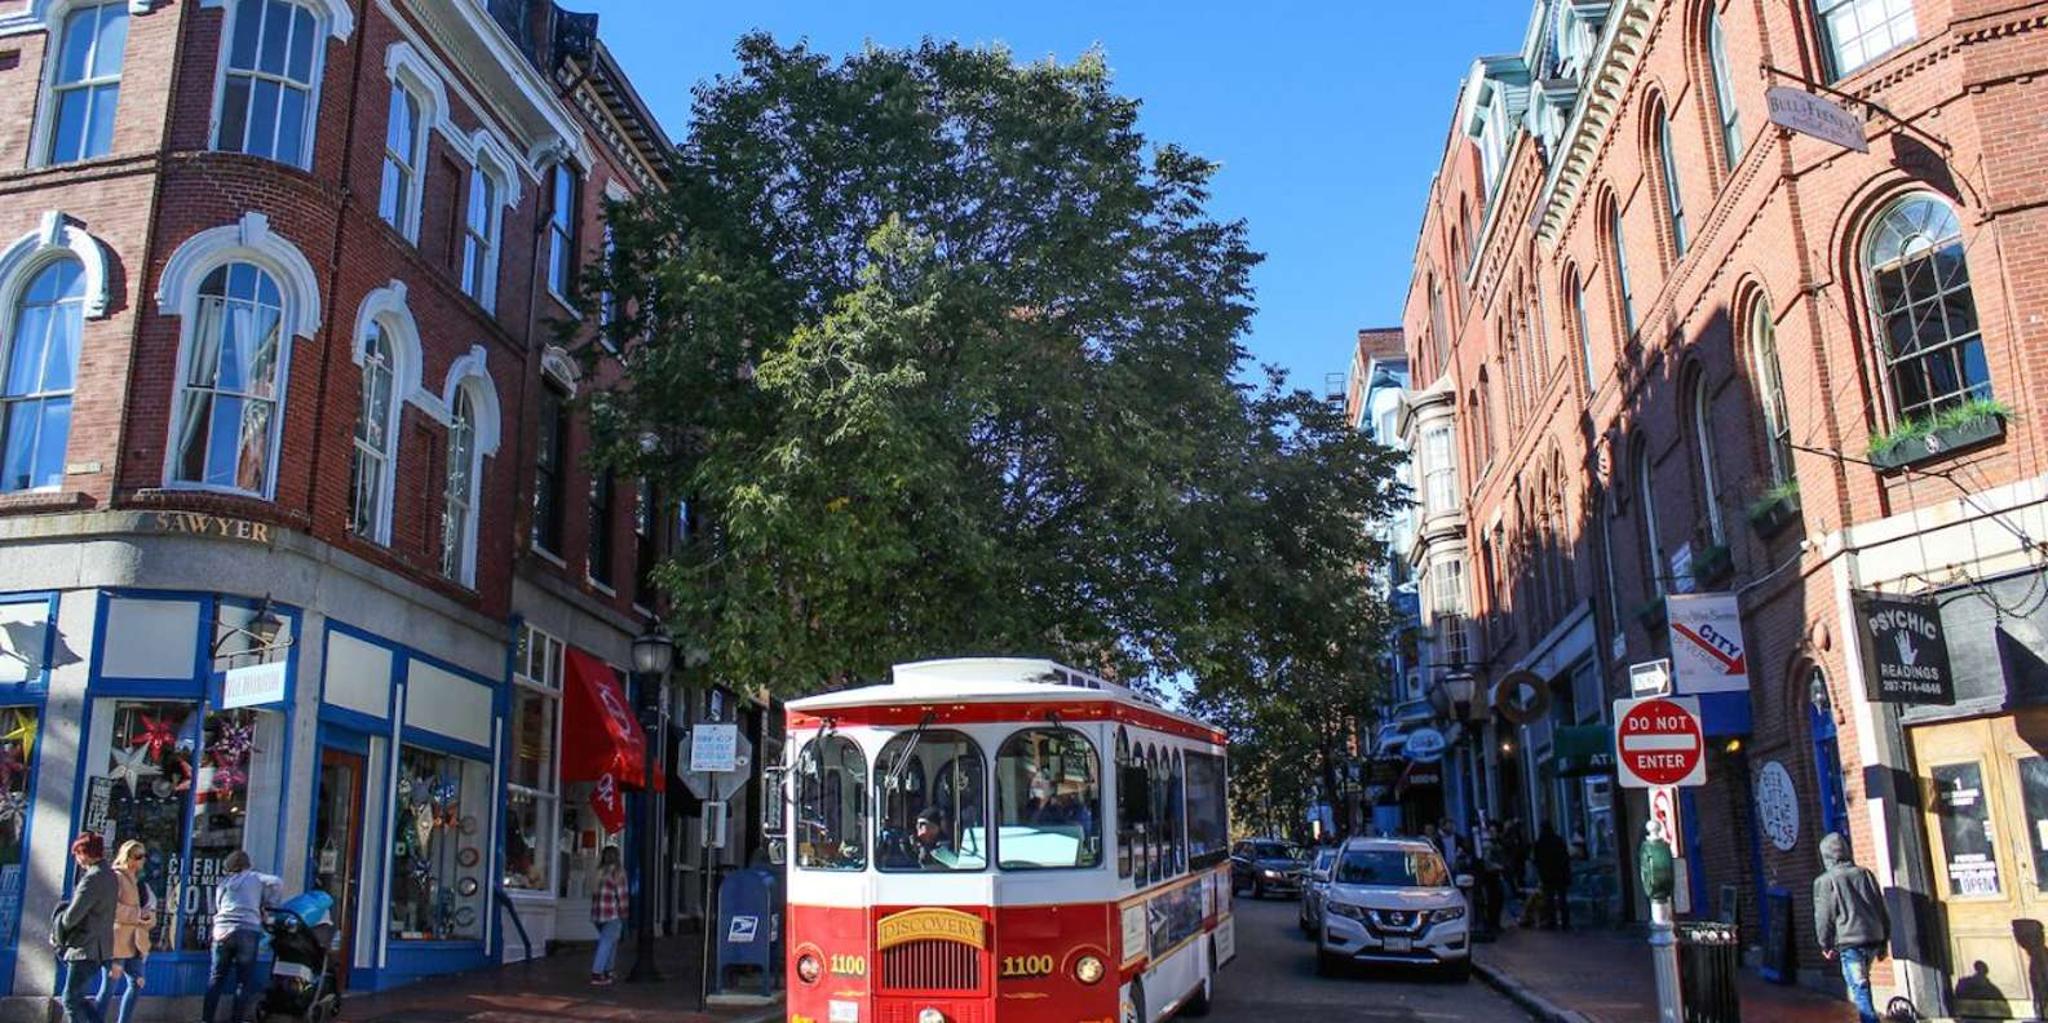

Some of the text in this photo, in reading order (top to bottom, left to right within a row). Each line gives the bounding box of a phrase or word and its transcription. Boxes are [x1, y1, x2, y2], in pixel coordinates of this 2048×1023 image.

[155, 512, 268, 542] SAWYER
[1868, 608, 1937, 640] PSYCHIC
[1699, 624, 1740, 657] CITY
[1880, 662, 1940, 681] READINGS
[1628, 715, 1688, 731] DO NOT
[1637, 754, 1686, 770] ENTER
[882, 917, 979, 938] DISCOVERY
[830, 955, 865, 976] 1100
[1002, 954, 1054, 976] 1100
